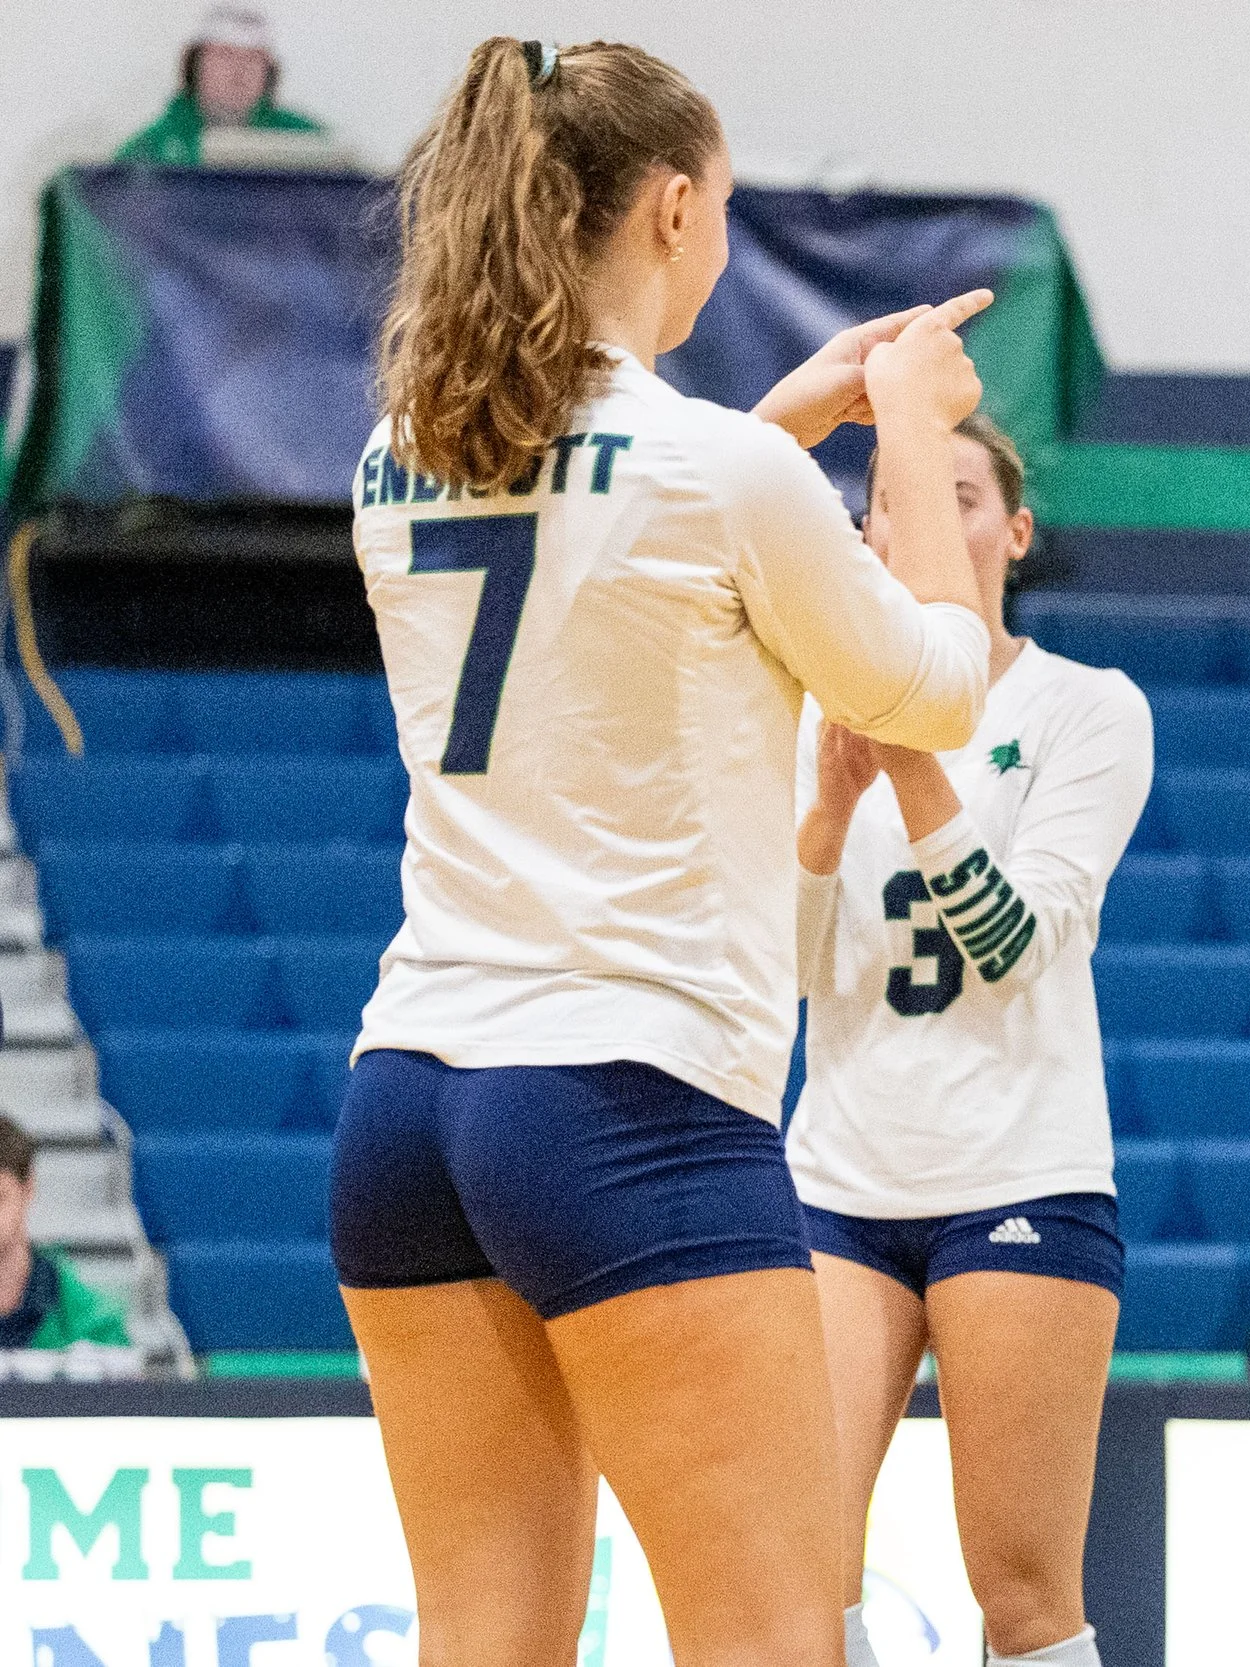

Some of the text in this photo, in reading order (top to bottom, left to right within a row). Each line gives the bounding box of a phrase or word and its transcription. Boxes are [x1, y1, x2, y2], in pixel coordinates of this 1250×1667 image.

[407, 511, 539, 775] 7
[882, 869, 964, 1018] 3
[929, 847, 1037, 984] GULLS
[20, 1467, 254, 1581] ME
